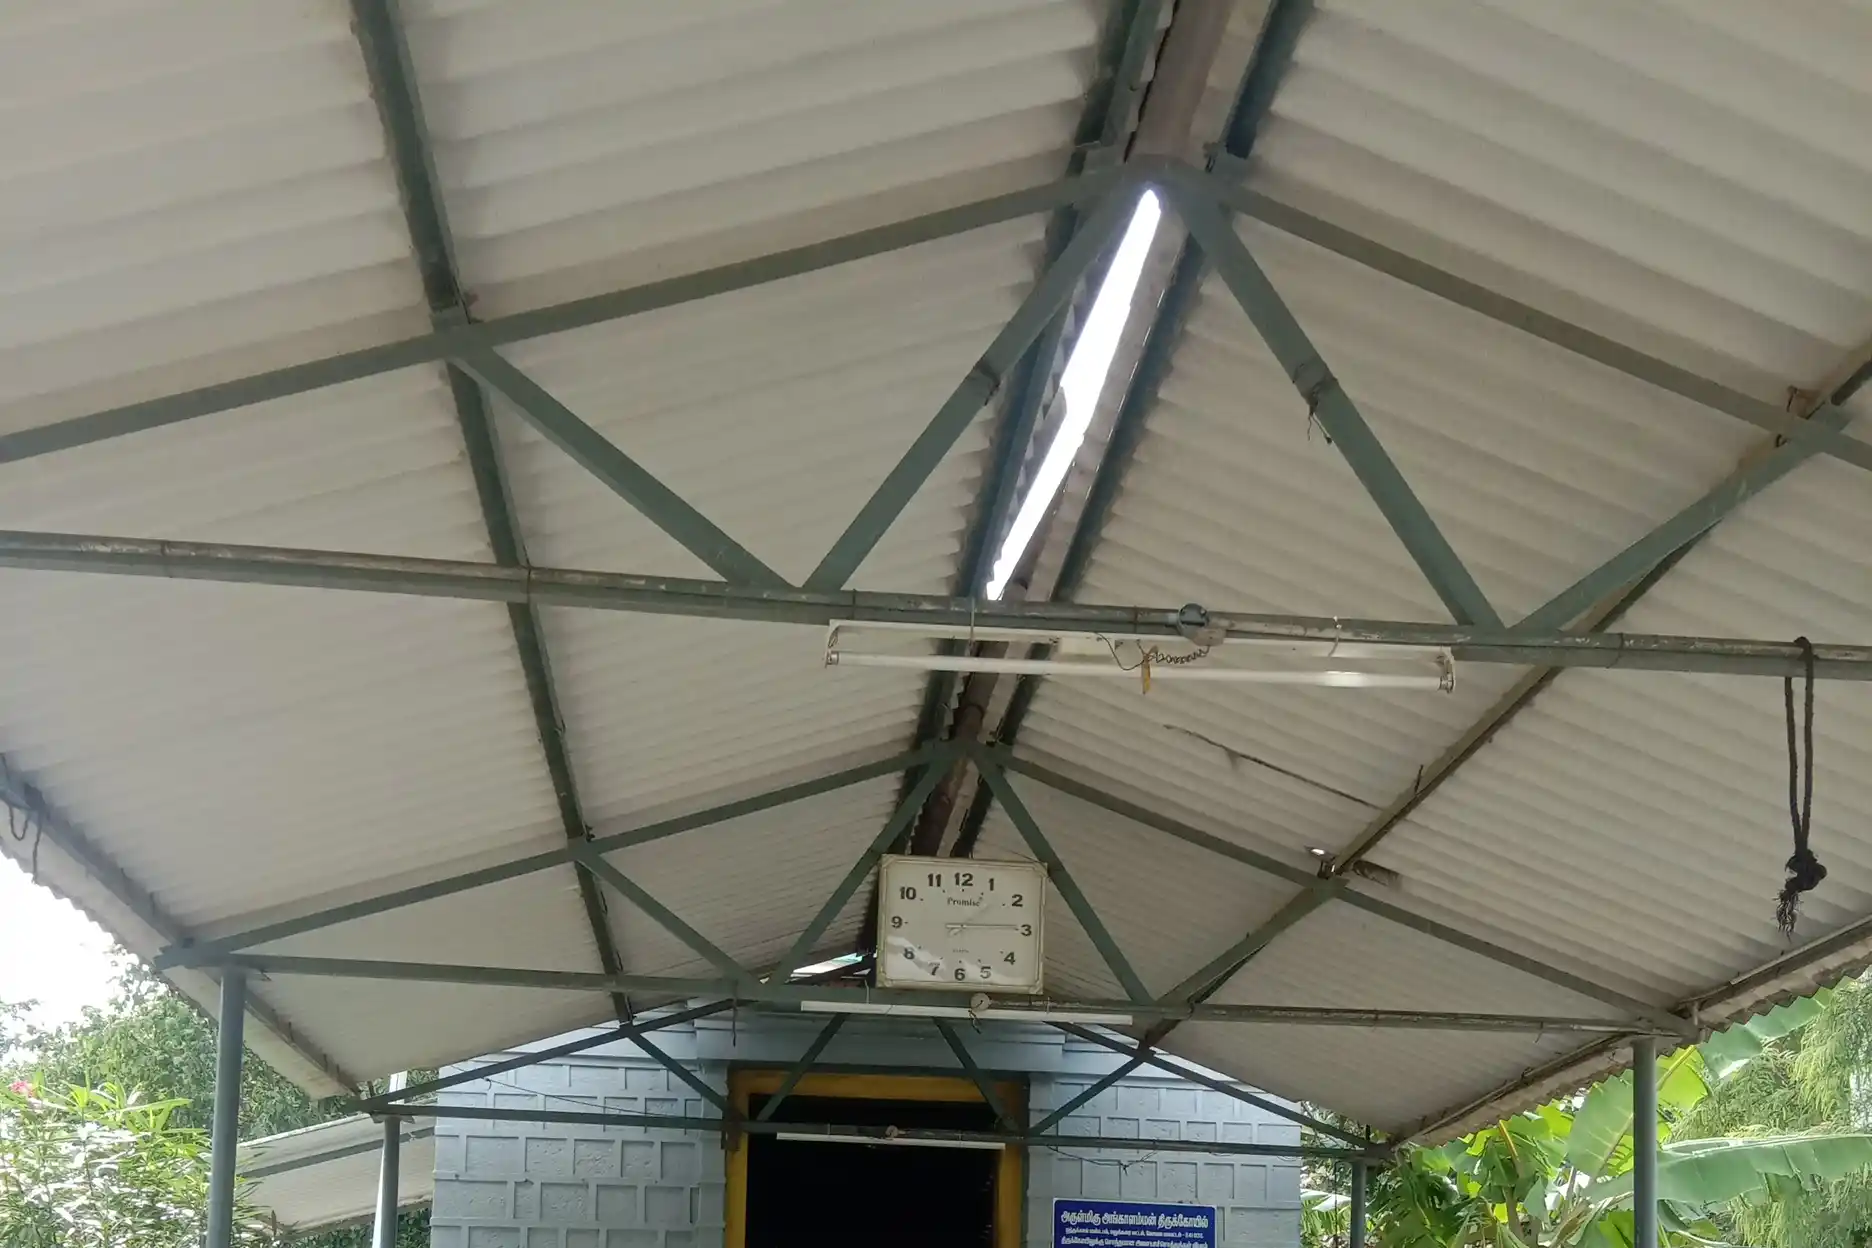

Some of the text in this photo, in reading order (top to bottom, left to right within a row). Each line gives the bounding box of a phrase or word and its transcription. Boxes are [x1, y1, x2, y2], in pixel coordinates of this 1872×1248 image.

[927, 873, 942, 887] 11
[954, 872, 974, 887] 12
[988, 878, 995, 891] 1
[900, 887, 916, 900] 10
[947, 897, 980, 907] Promise
[1011, 894, 1023, 907] 2
[891, 916, 903, 928] 9
[1021, 924, 1032, 936] 3
[903, 947, 915, 960] 8
[1004, 952, 1016, 965] 4
[929, 962, 940, 976] 7
[954, 968, 965, 981] 6
[980, 966, 991, 979] 5
[1102, 1212, 1156, 1226] அங்காளம்மன்
[1158, 1213, 1208, 1229] திருக்கோயில்
